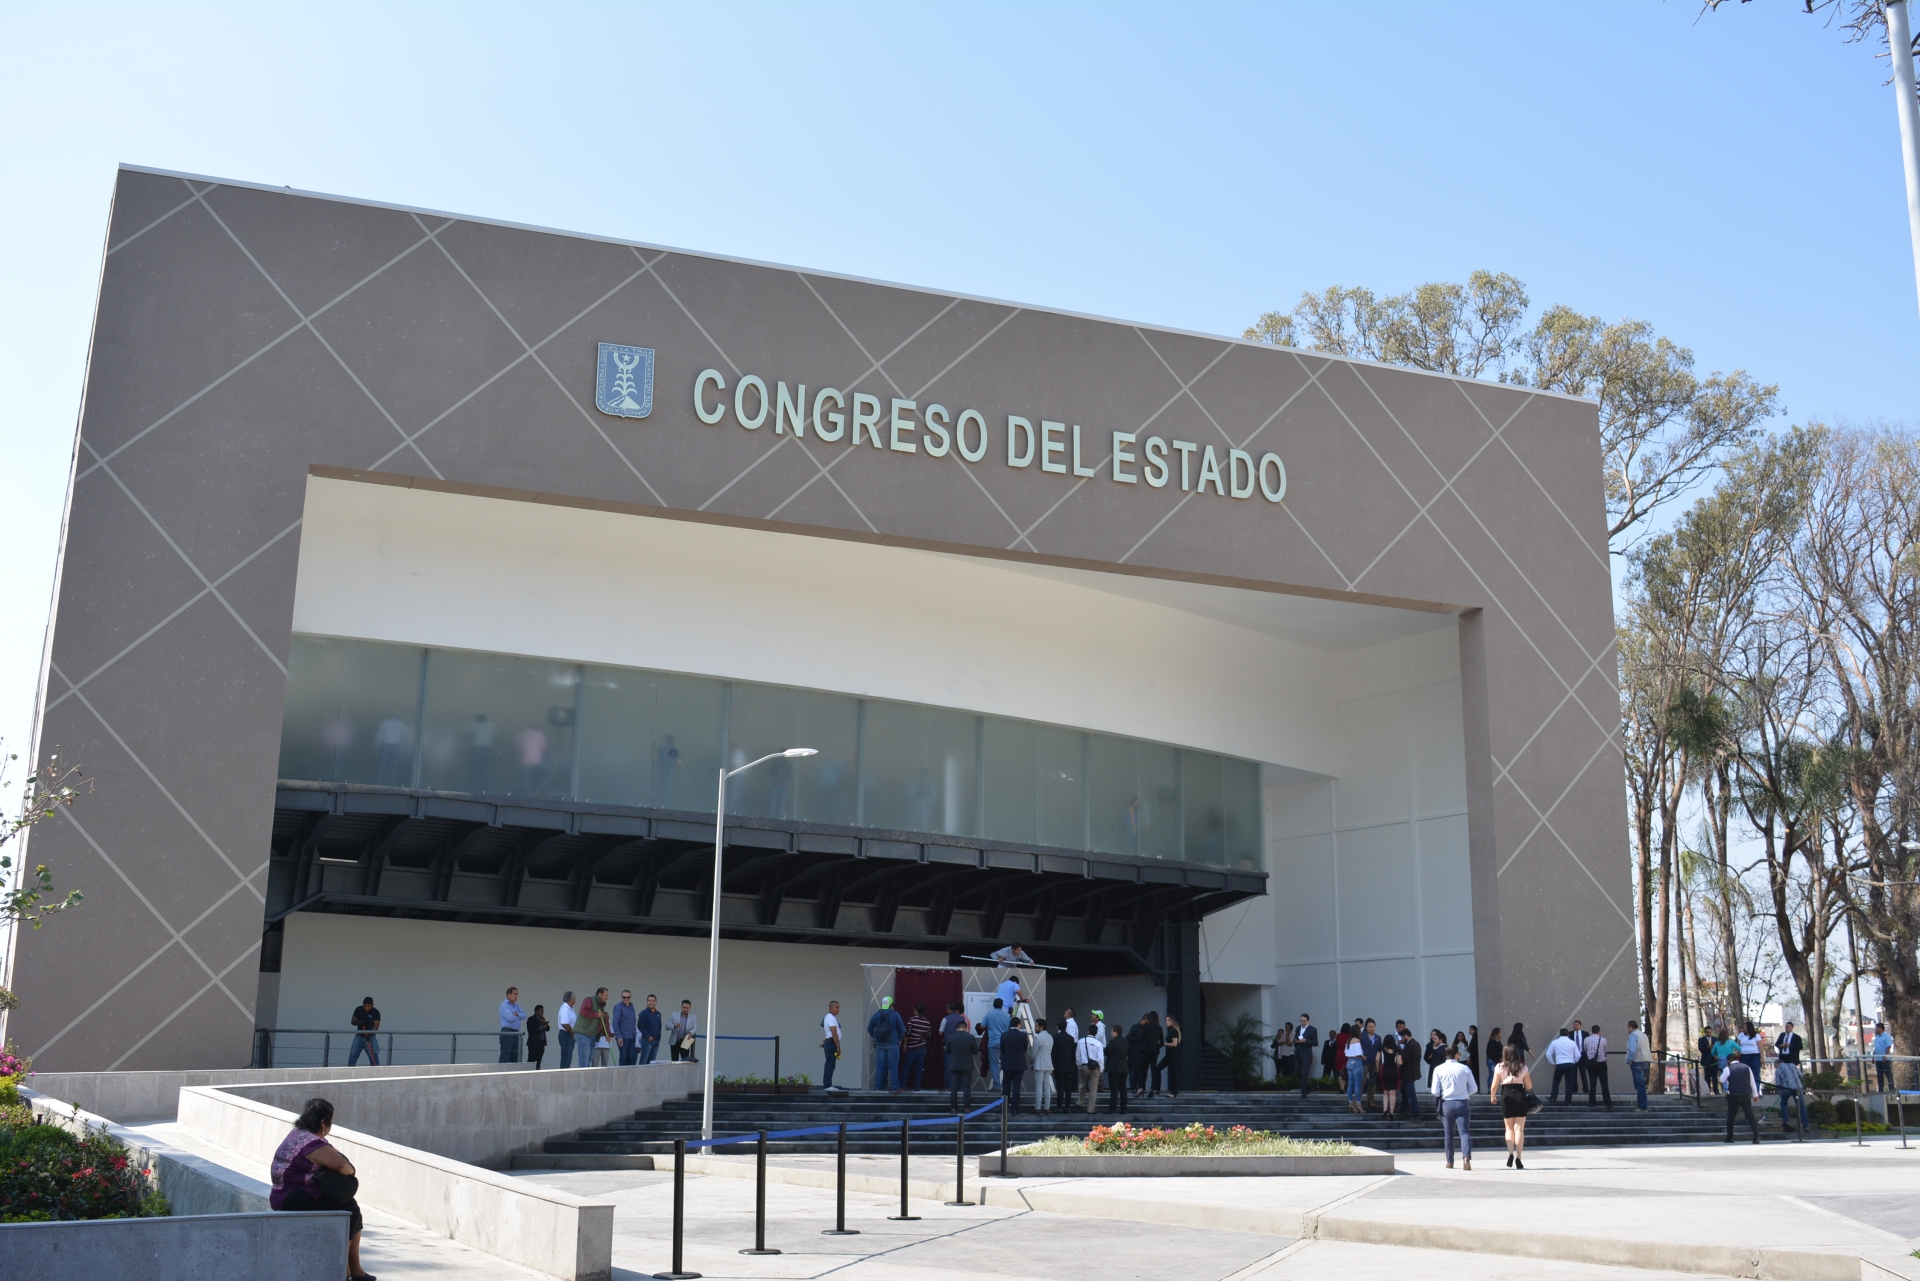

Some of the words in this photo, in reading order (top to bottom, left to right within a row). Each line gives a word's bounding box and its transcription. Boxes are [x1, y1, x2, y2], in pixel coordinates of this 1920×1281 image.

[693, 368, 988, 463] CONGRESO
[1007, 415, 1095, 479] DEL
[1112, 430, 1287, 504] ESTADO
